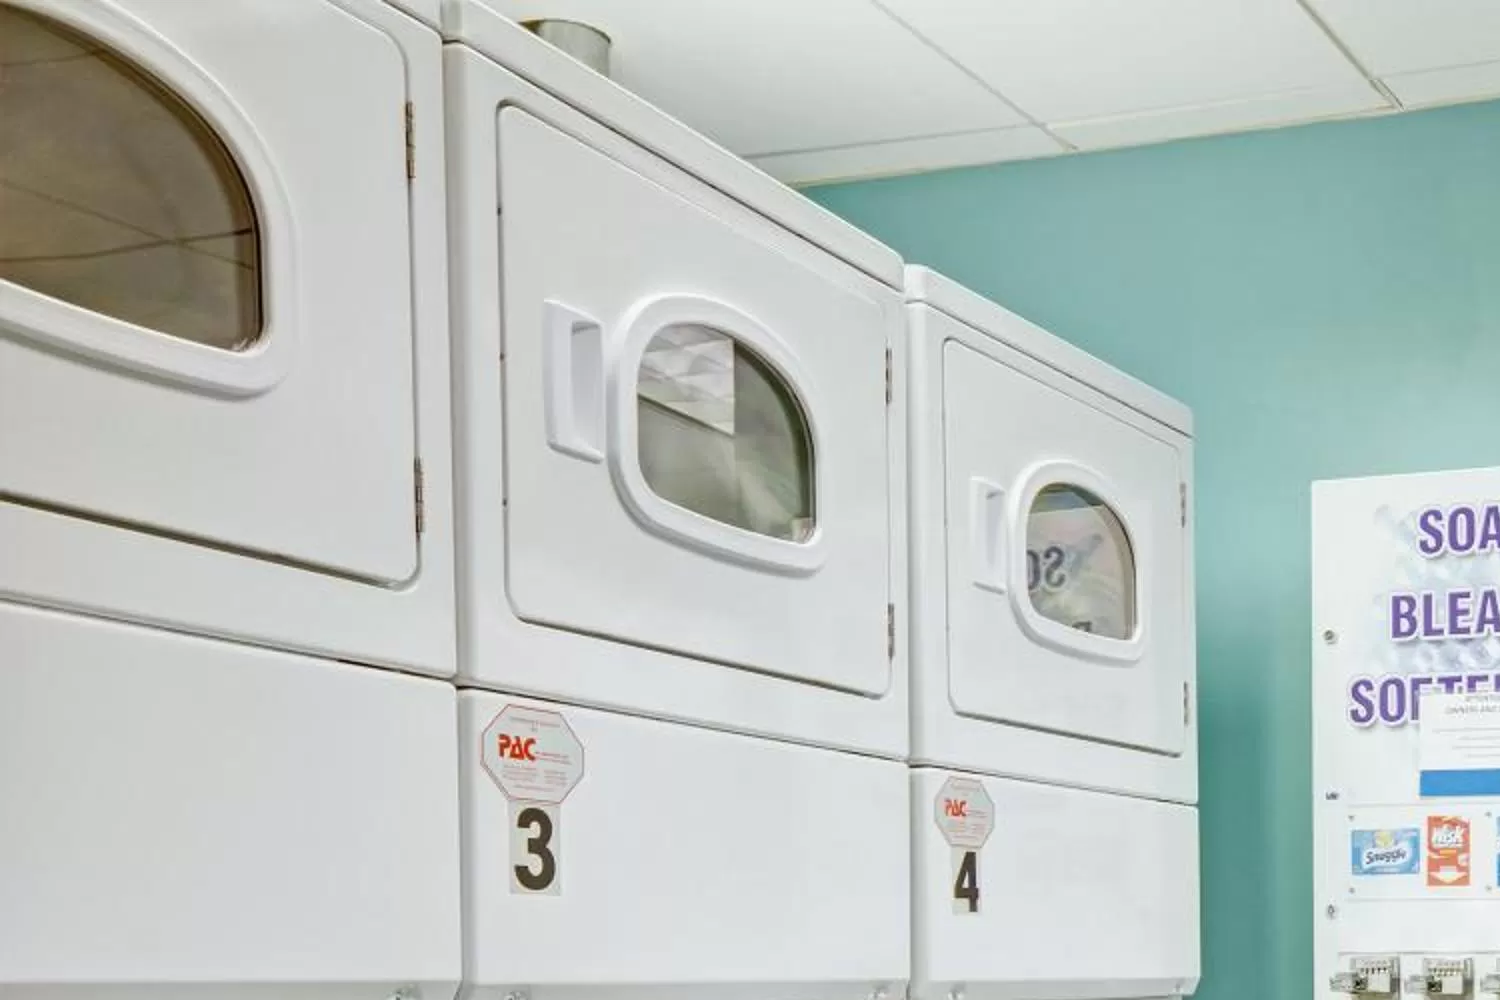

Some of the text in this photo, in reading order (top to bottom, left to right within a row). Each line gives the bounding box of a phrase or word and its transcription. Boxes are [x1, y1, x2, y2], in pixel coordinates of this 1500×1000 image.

[498, 733, 537, 762] PAC
[514, 807, 556, 891] 3
[954, 851, 979, 912] 4
